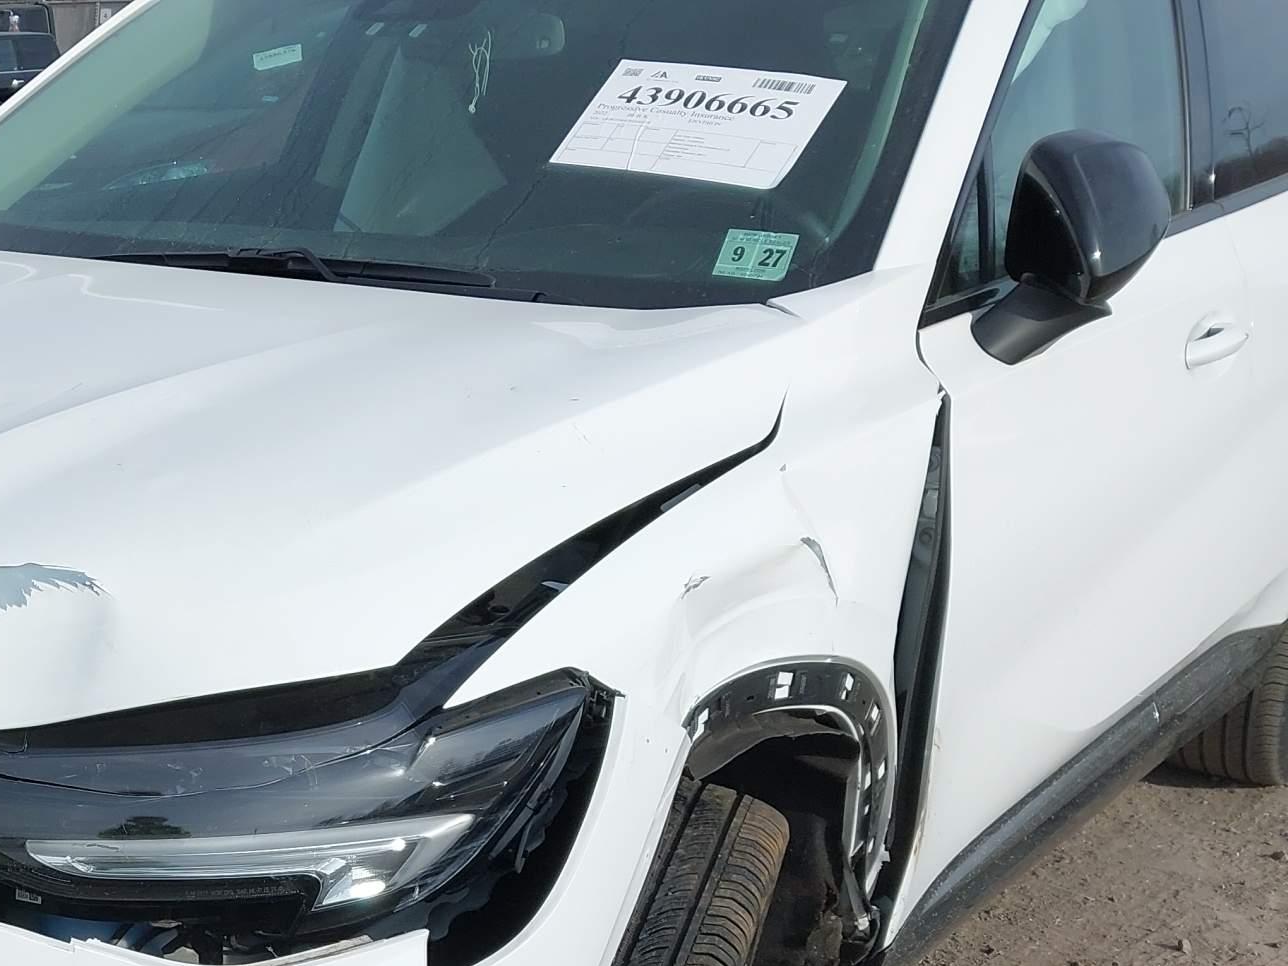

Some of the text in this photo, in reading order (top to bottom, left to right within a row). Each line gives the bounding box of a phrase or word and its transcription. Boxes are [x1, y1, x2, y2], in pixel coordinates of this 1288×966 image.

[596, 103, 648, 114] Progressive
[650, 106, 688, 117] Casualty
[690, 110, 736, 121] Insurance
[616, 85, 801, 120] 43906665
[731, 246, 787, 268] 9 27
